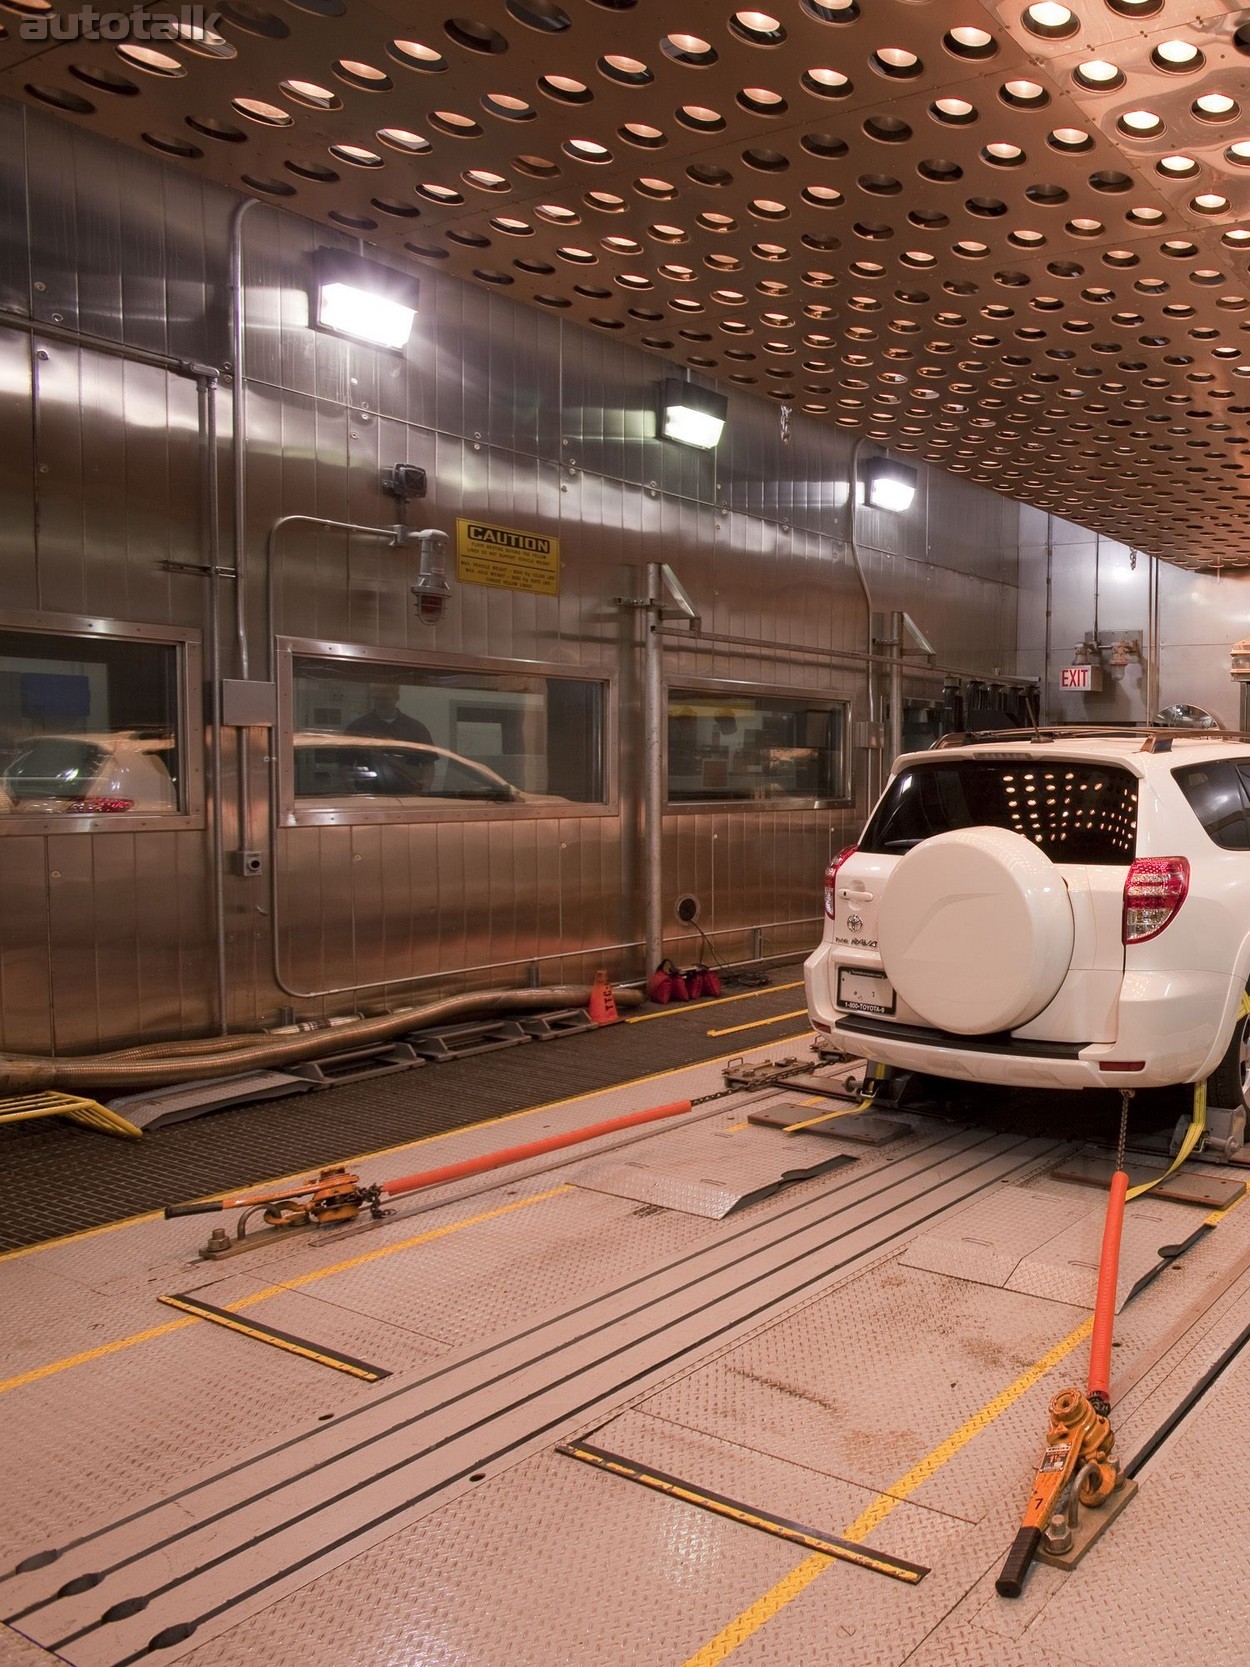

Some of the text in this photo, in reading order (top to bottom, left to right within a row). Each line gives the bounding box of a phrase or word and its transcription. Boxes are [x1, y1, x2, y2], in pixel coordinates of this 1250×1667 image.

[469, 526, 549, 553] CAUTION
[1062, 669, 1088, 687] EXIT
[1034, 1497, 1044, 1510] 7
